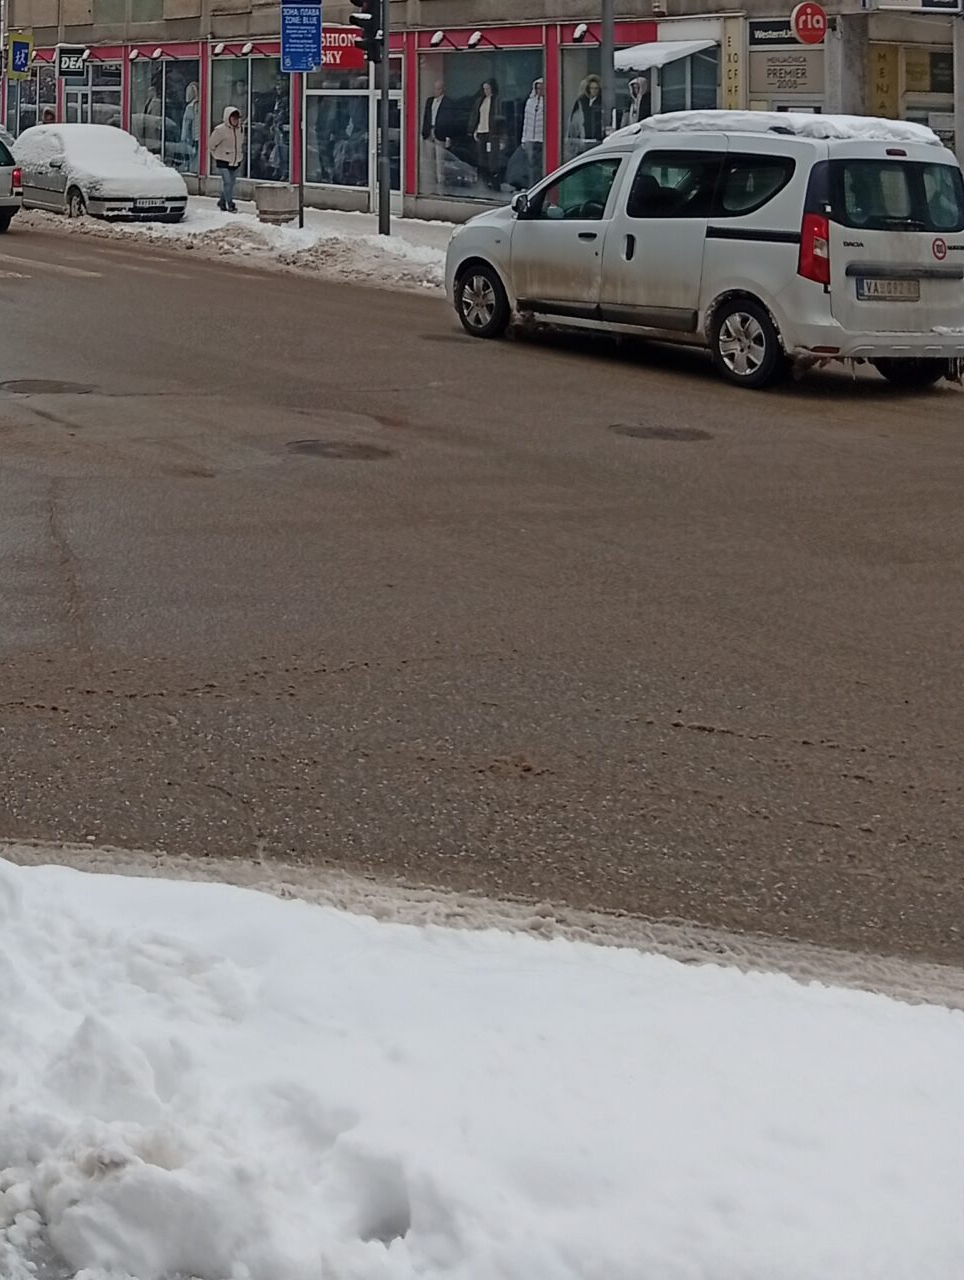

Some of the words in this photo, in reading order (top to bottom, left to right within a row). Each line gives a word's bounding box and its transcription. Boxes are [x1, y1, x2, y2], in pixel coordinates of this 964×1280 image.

[302, 16, 318, 24] BLUE
[798, 7, 824, 29] ria
[321, 33, 356, 47] SHION
[766, 67, 807, 79] PREMIER
